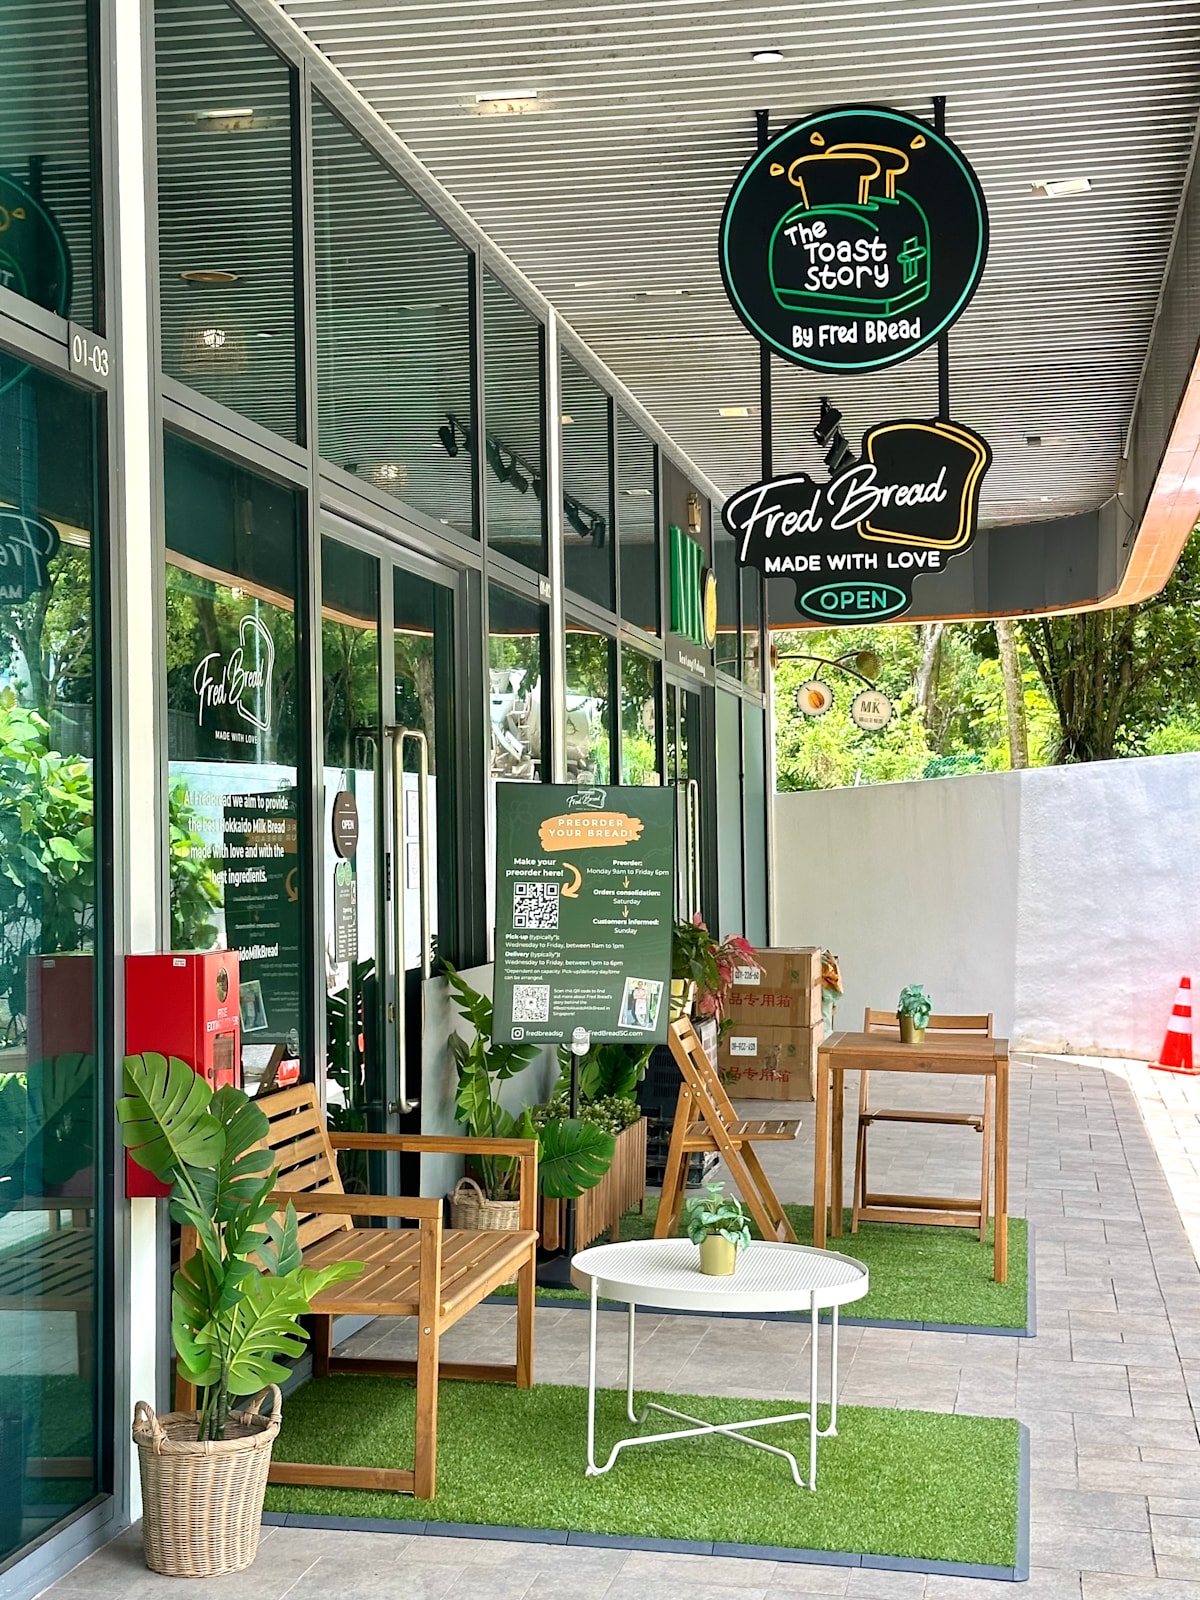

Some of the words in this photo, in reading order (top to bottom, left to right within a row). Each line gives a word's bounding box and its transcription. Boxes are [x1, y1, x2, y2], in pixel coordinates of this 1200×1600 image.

[784, 220, 828, 246] The
[803, 235, 887, 264] Toast
[792, 324, 814, 349] By
[818, 321, 858, 348] Fred
[73, 334, 109, 377] 01-03
[727, 477, 823, 562] Fred
[827, 464, 947, 531] Bread
[765, 555, 822, 573] MADE
[826, 553, 878, 571] WITH
[887, 551, 941, 569] LOVE
[820, 590, 887, 611] OPEN
[193, 652, 227, 727] Fred
[227, 647, 265, 705] Bread
[860, 700, 881, 714] MK
[214, 730, 230, 741] MADE
[231, 732, 244, 743] WITH
[245, 734, 259, 745] LOVE
[232, 796, 243, 808] we
[244, 794, 257, 809] aim
[257, 795, 265, 809] to
[265, 795, 289, 812] provide
[188, 817, 199, 832] the
[218, 817, 251, 833] Hokkaido
[252, 818, 267, 834] Milk
[267, 819, 286, 834] Bread
[341, 819, 355, 831] OPEN
[558, 818, 623, 827] PREORDER
[549, 829, 582, 838] YOUR
[587, 829, 633, 838] BREAD!
[190, 844, 212, 858] made
[212, 843, 229, 858] with
[229, 843, 244, 858] love
[244, 844, 258, 858] and
[259, 844, 273, 858] with
[273, 845, 285, 858] the
[514, 858, 536, 866] Make
[537, 859, 556, 867] your
[613, 859, 643, 867] Preorder:
[211, 868, 228, 885] best
[228, 867, 268, 888] ingredients.
[506, 868, 542, 878] preorder
[543, 868, 564, 877] here!
[586, 868, 611, 876] Monday
[635, 869, 654, 877] Friday
[655, 869, 670, 877] 6pm
[616, 889, 661, 897] consolidation:
[613, 898, 641, 906] Saturday
[628, 918, 660, 926] informed:
[614, 927, 638, 935] Sunday
[239, 943, 279, 962] idoMilkBread
[525, 1030, 564, 1038] fredbreadsg
